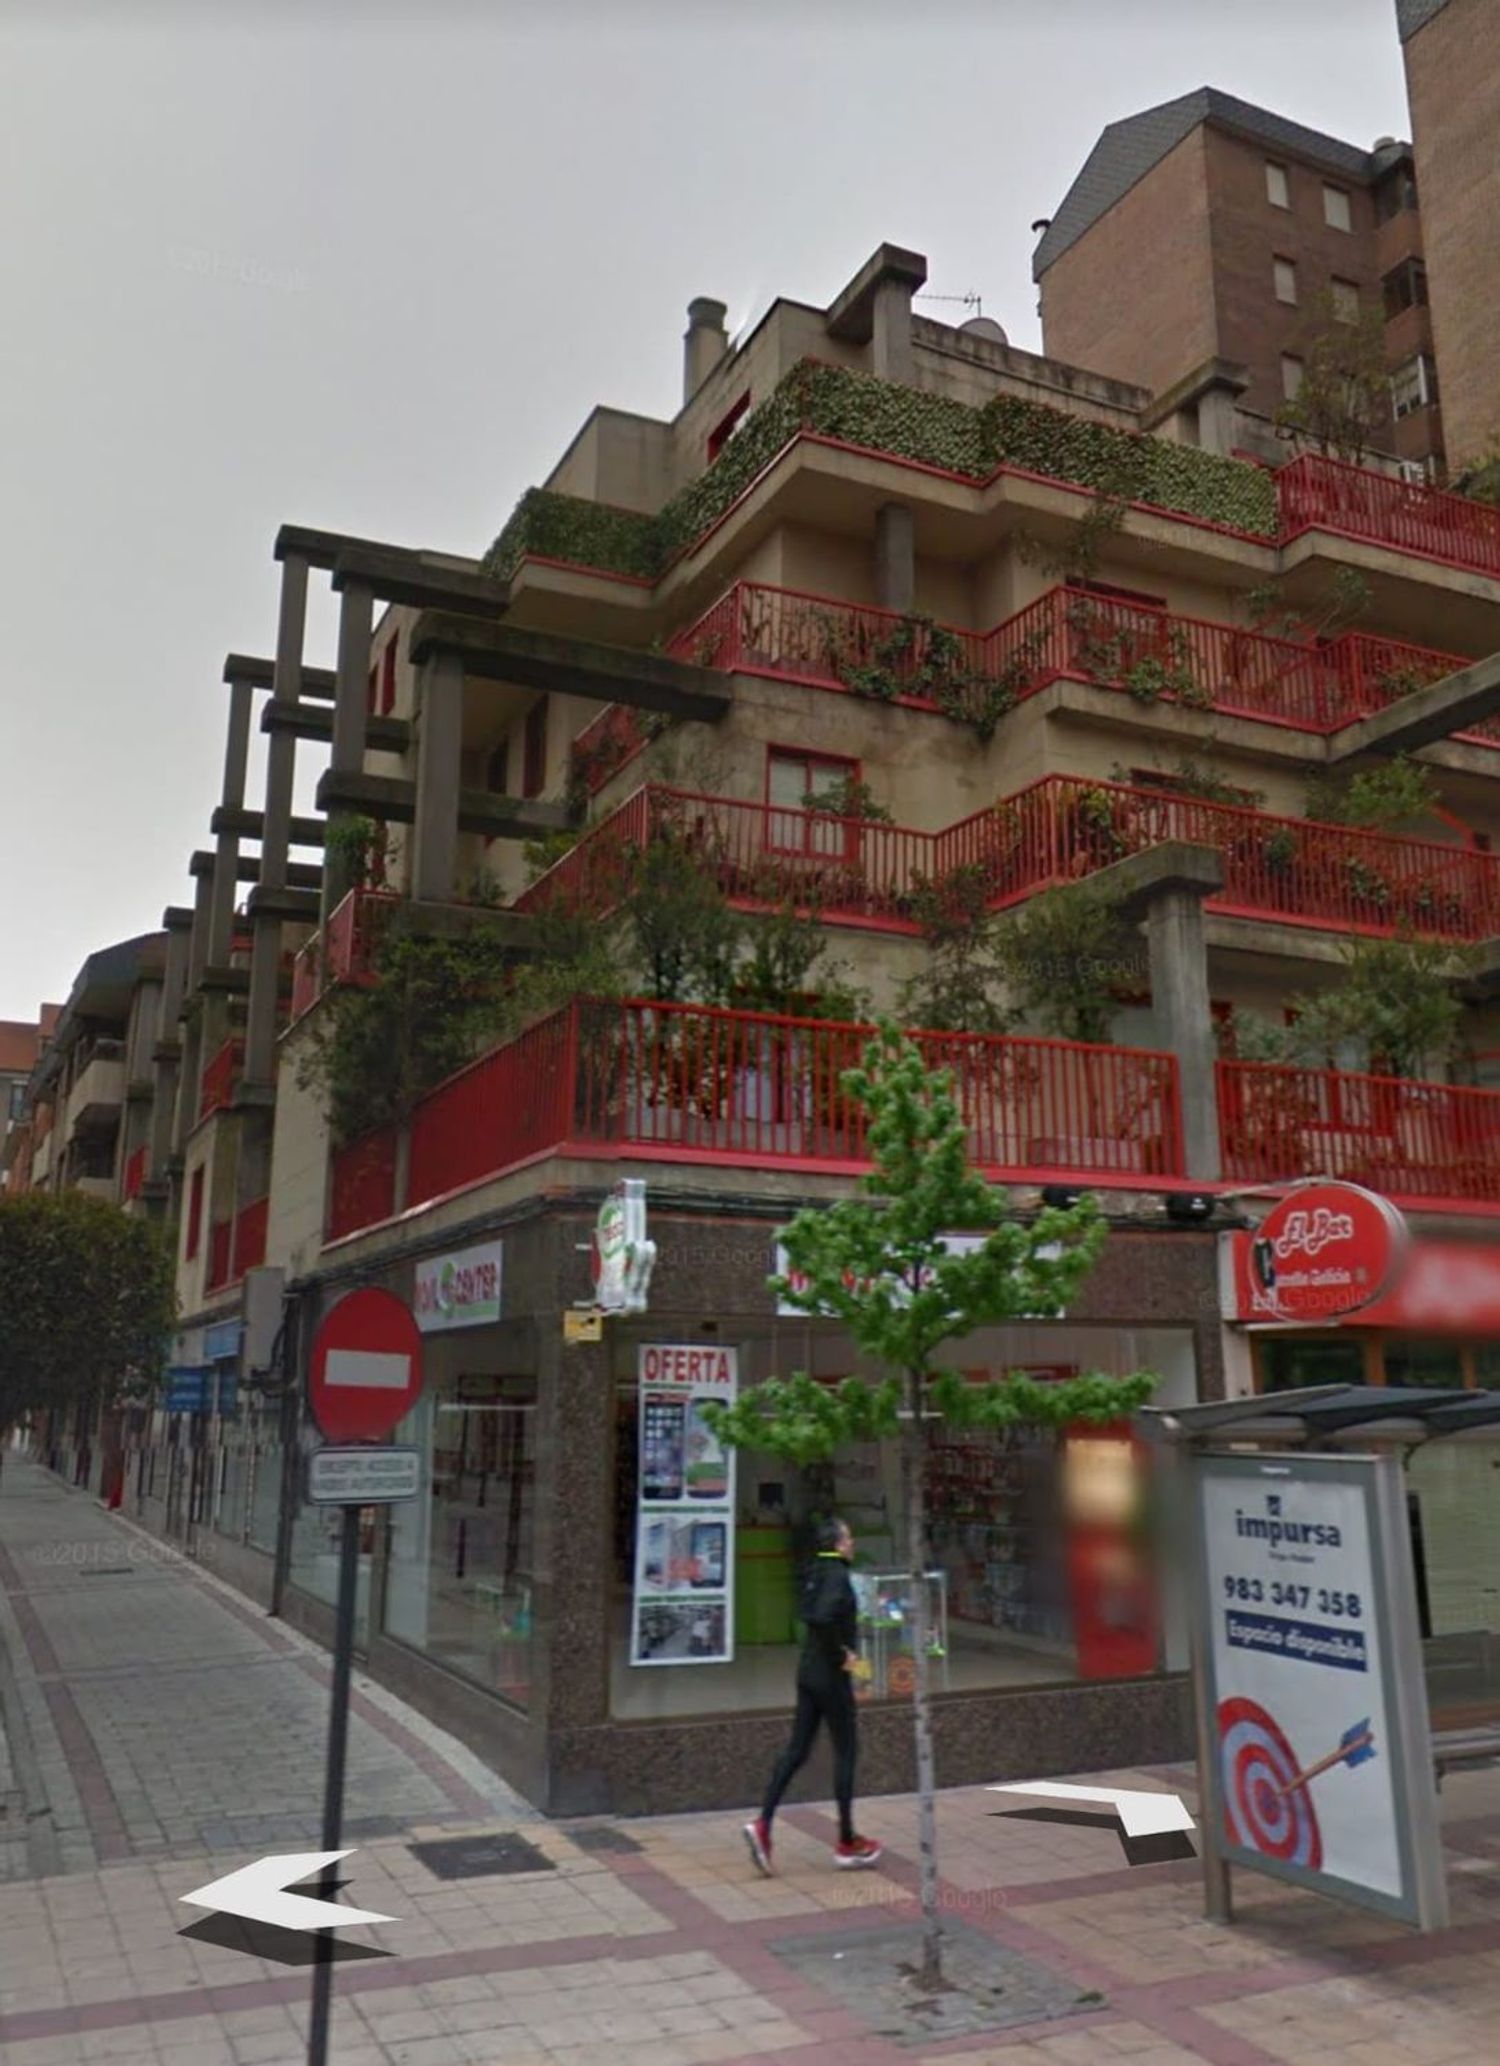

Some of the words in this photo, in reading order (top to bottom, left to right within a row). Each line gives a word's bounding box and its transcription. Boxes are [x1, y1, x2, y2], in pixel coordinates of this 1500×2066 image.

[644, 1348, 731, 1382] OFERTA
[1236, 1509, 1341, 1548] impursa
[1224, 1575, 1263, 1601] 983
[1271, 1583, 1311, 1609] 347
[1318, 1590, 1362, 1618] 358
